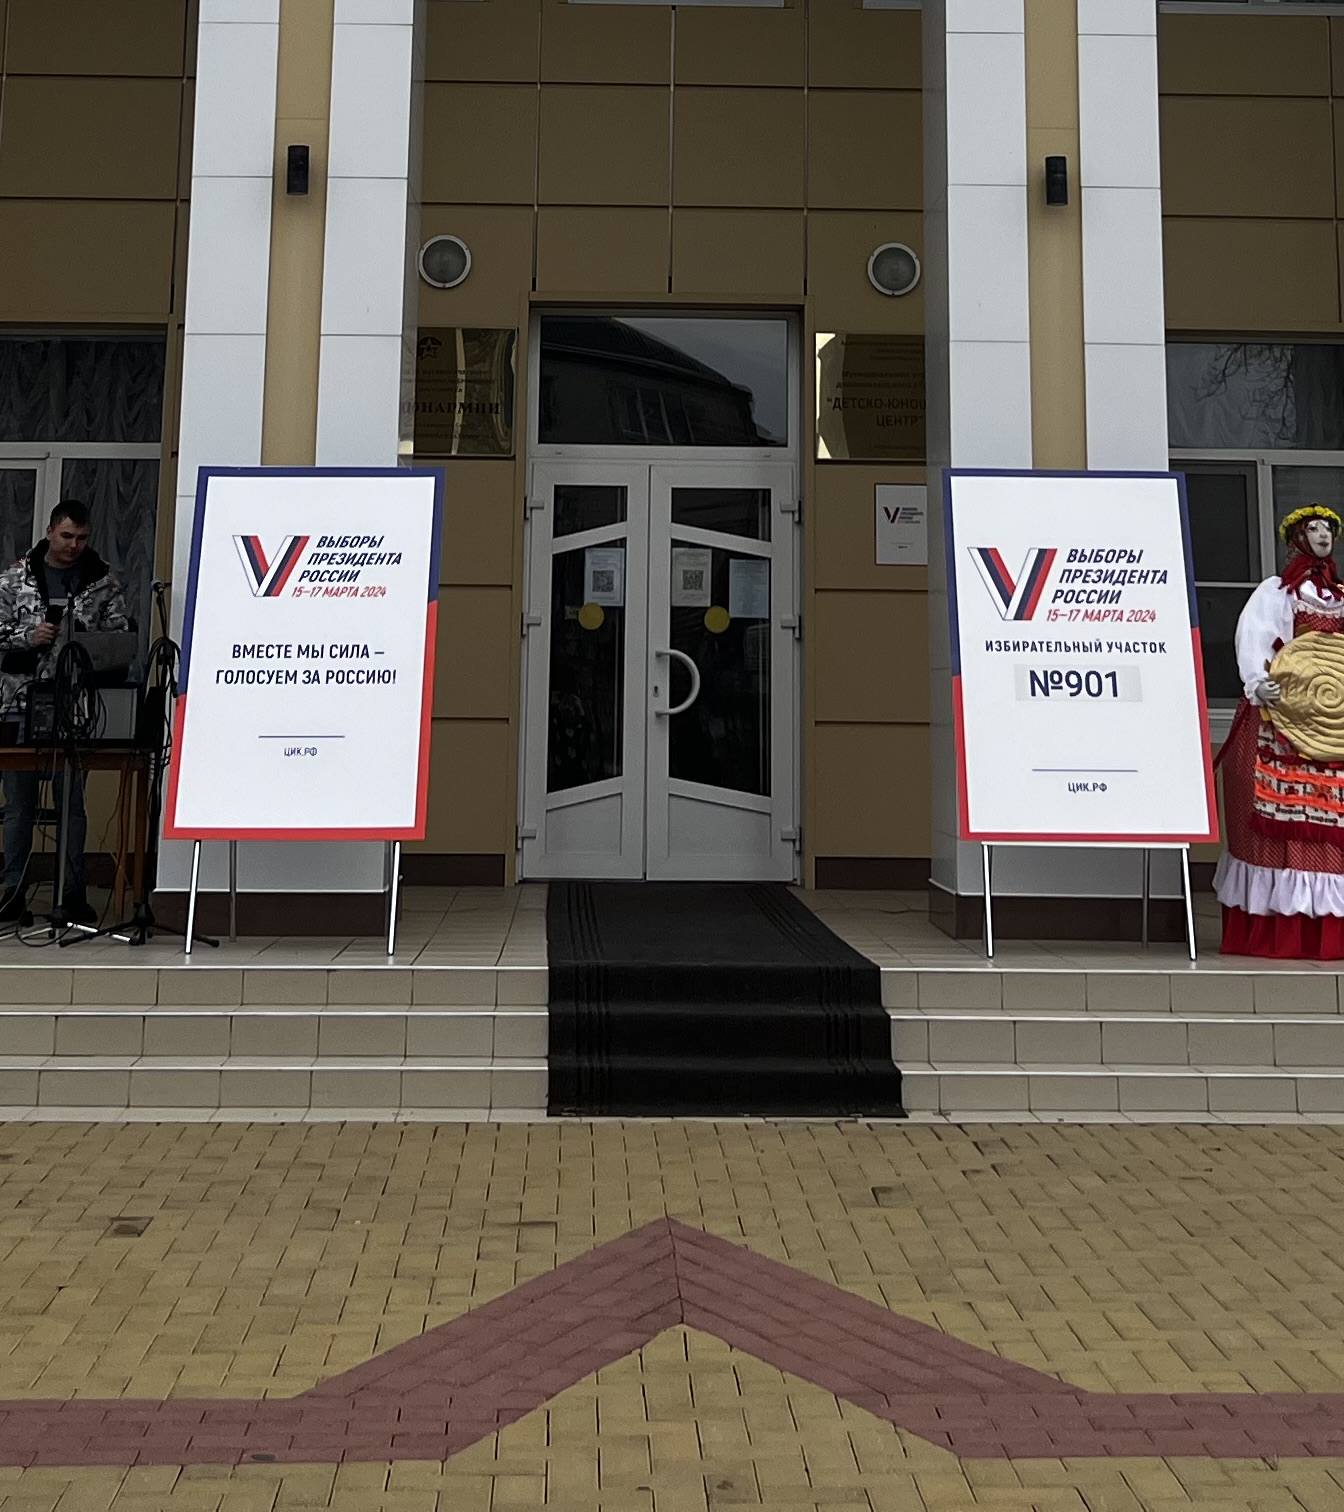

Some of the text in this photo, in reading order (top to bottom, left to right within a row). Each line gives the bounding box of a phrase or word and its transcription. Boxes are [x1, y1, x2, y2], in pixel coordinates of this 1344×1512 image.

[316, 535, 384, 548] ВЫБОРЫ
[307, 552, 402, 567] ПРЕЗИДЕНТА
[1066, 548, 1144, 564] ВЫБОРЫ
[298, 569, 361, 583] РОССИИ
[1059, 569, 1168, 586] ПРЕЗИДЕНТА
[322, 586, 360, 597] МАРТА
[360, 586, 387, 597] 2024
[1051, 589, 1122, 604] РОССИИ
[1081, 609, 1124, 622] МАРТА
[1125, 609, 1157, 623] 2024
[232, 644, 292, 659] ВМЕСТЕ
[296, 644, 325, 659] МЫ
[329, 644, 370, 659] СИЛА
[985, 638, 1167, 654] ИЗБИРАТЕЛЬНЫЙ УЧАСТОК
[216, 669, 397, 684] ГОЛОСУЕМ ЗА РОССИЮ!
[1029, 670, 1119, 698] №901
[283, 746, 318, 757] ЦИК.РФ
[1067, 781, 1108, 793] ЦИК.РФ
